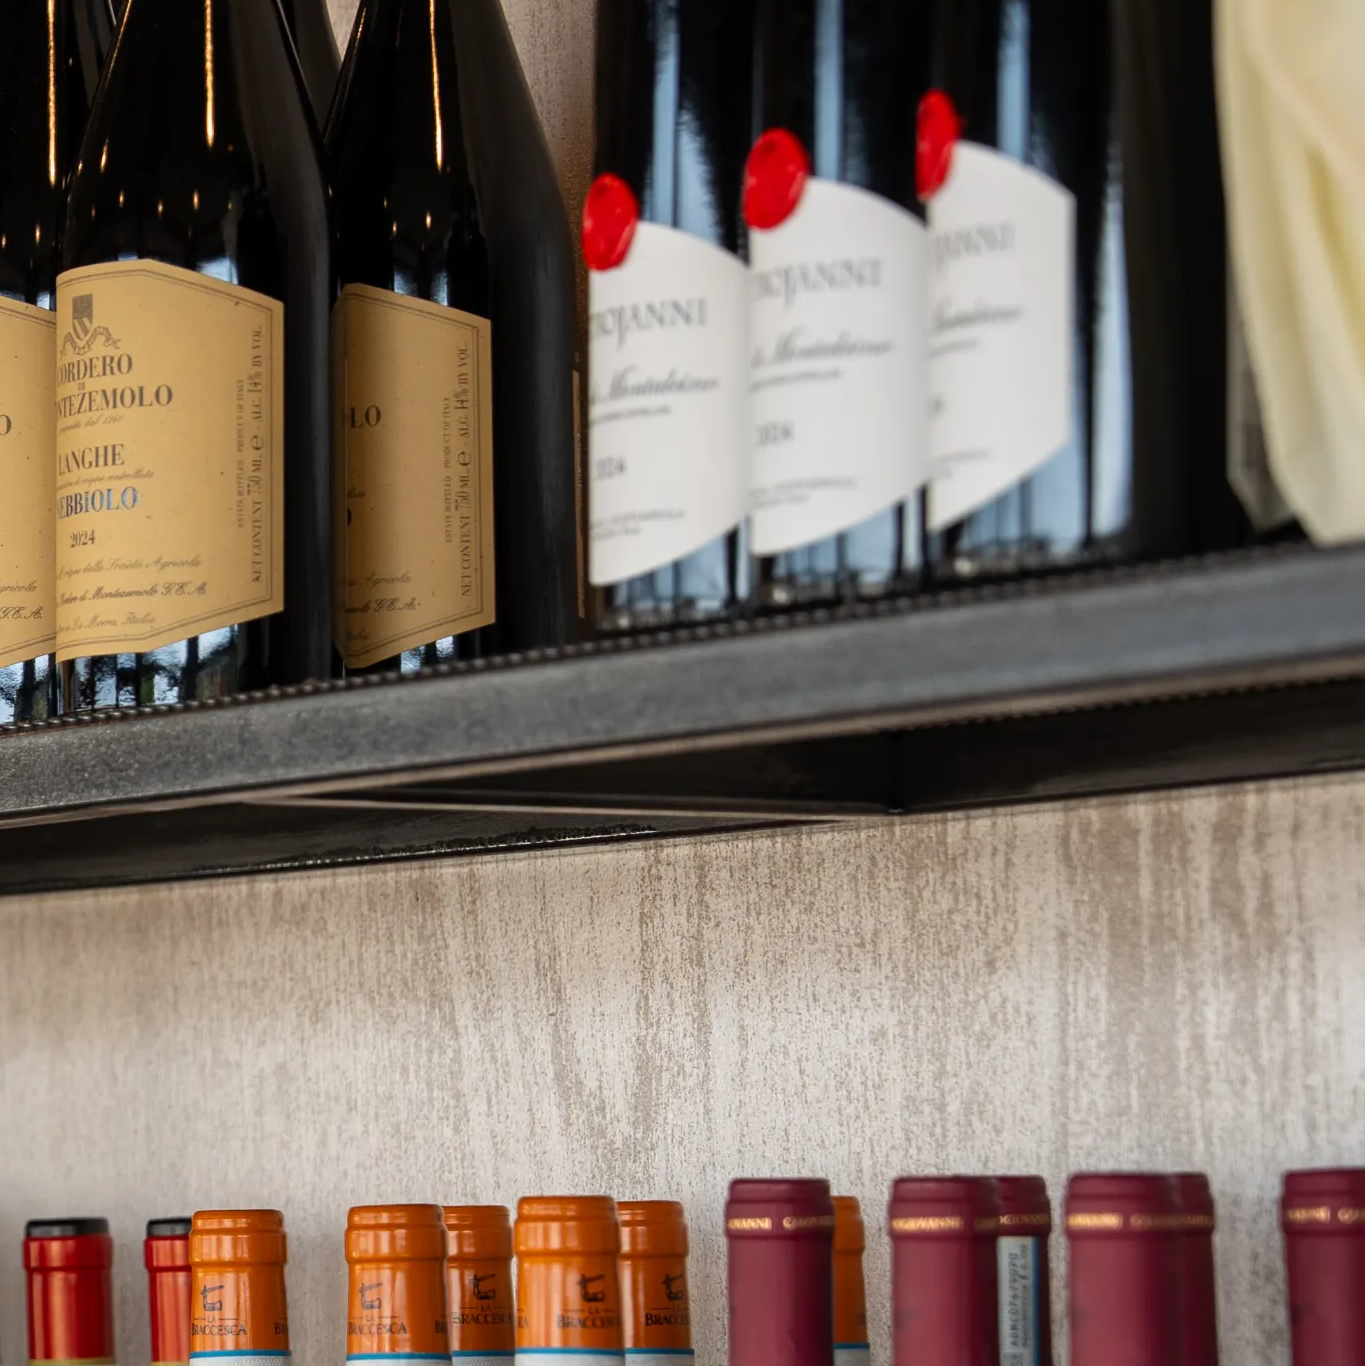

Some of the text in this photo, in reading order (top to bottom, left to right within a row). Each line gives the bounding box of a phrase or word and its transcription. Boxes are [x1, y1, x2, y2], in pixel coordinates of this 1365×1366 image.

[58, 443, 125, 476] LANGHE
[70, 529, 96, 548] 2024
[459, 515, 471, 570] CONTENT
[459, 574, 471, 597] NET
[207, 1315, 216, 1323] LA
[191, 1323, 247, 1337] BRACCESCA
[348, 1322, 408, 1336] BRACCESCA
